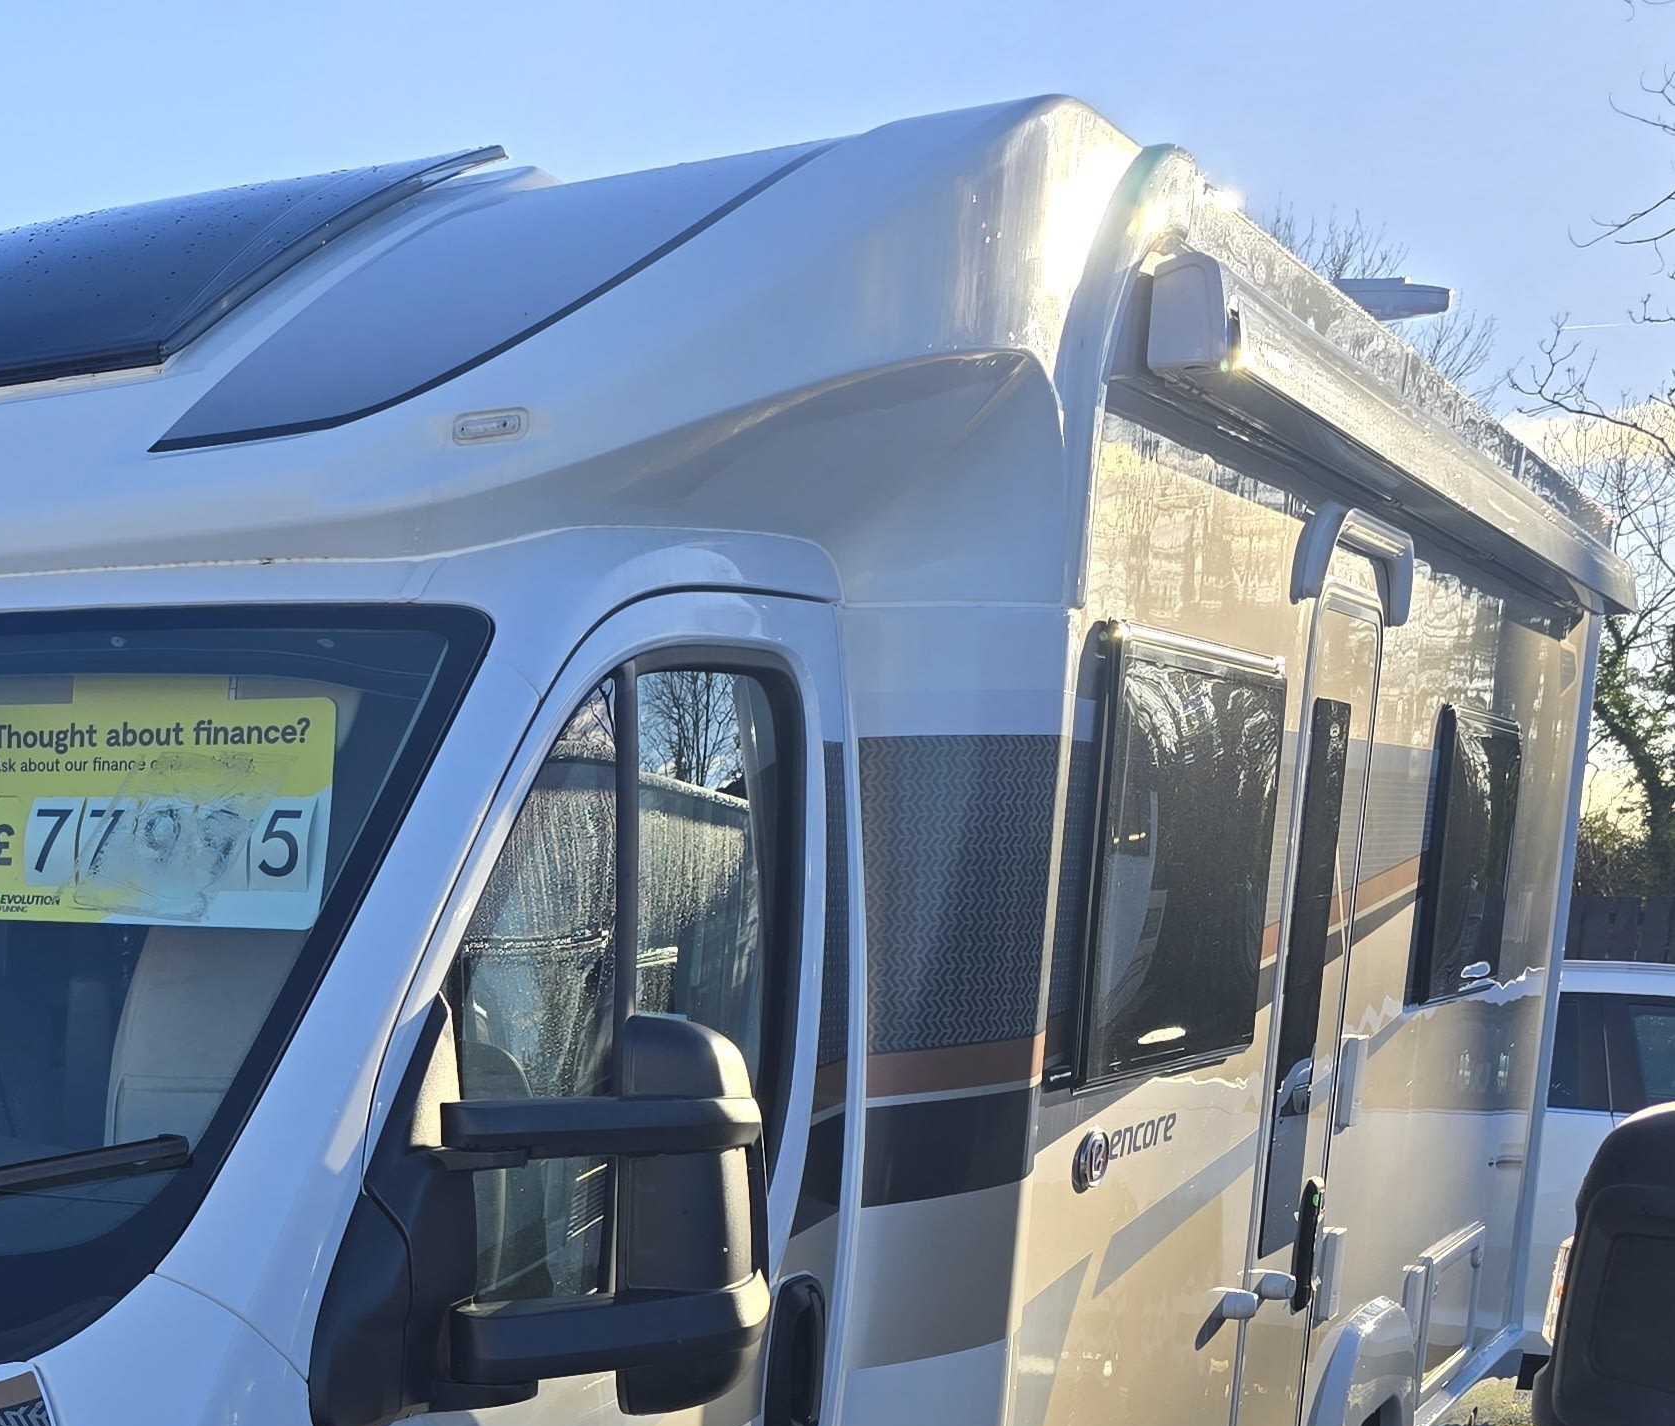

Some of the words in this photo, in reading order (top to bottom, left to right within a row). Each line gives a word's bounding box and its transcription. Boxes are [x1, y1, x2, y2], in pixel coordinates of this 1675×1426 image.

[106, 721, 184, 747] about
[193, 717, 311, 747] finance?
[20, 757, 62, 773] about
[64, 759, 88, 773] our
[92, 756, 147, 773] finance
[0, 894, 61, 906] EVOLUTION
[1108, 1112, 1177, 1161] encore
